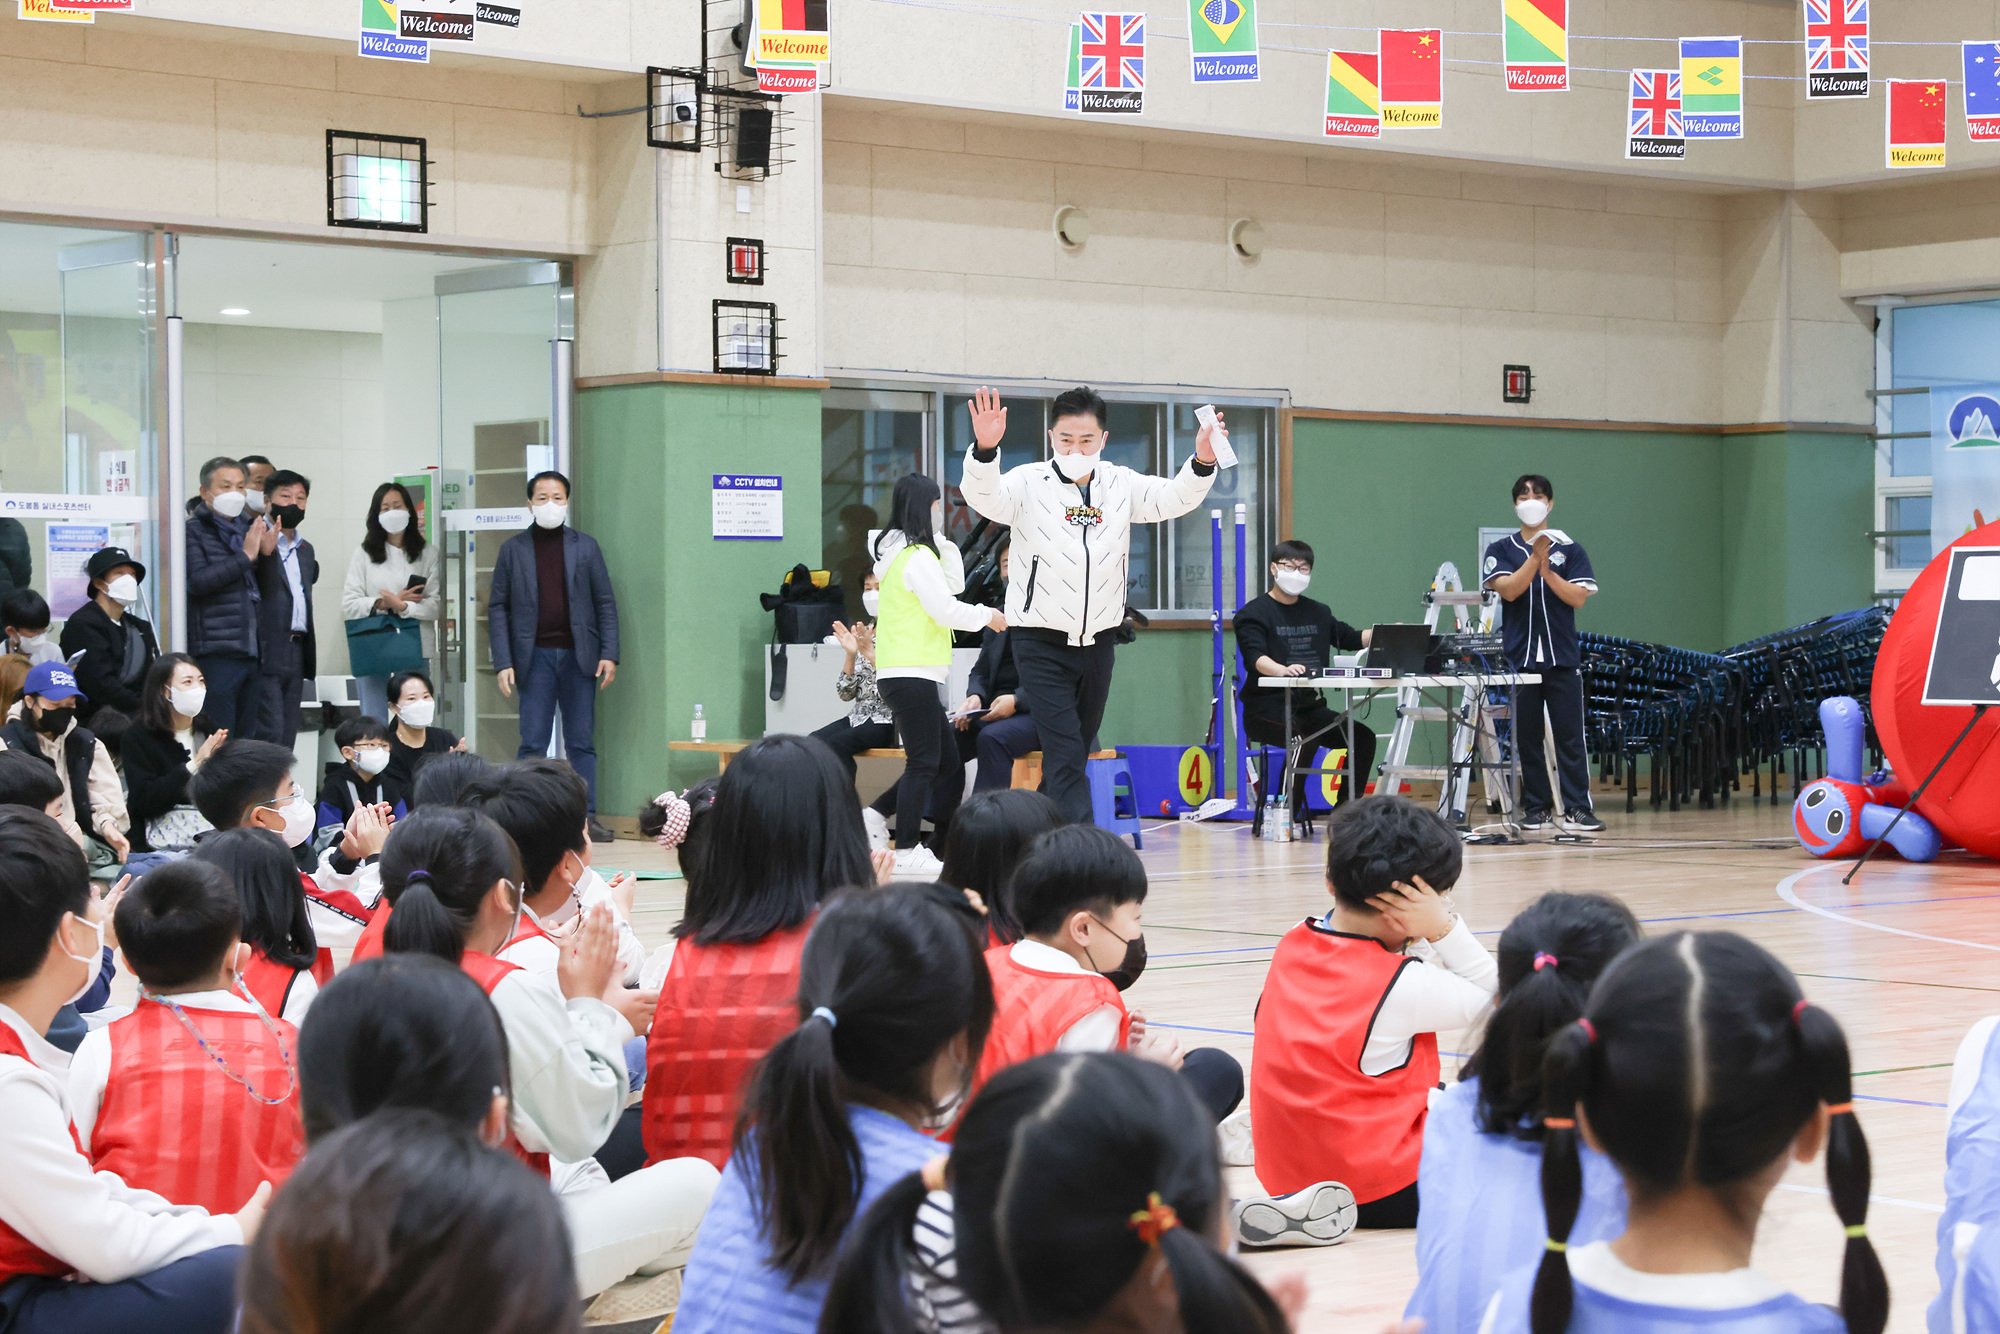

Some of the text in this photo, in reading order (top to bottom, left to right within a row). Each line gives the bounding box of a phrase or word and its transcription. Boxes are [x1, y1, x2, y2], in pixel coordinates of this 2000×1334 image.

[401, 15, 473, 35] Welcome
[362, 36, 427, 56] Welcome
[762, 38, 828, 55] Welcome
[1194, 61, 1257, 77] Welcome
[1507, 69, 1566, 85] Welcome
[757, 72, 816, 88] Welcome
[1810, 77, 1868, 92] Welcome
[1082, 93, 1141, 109] Welcome
[1383, 109, 1439, 123] Welcome
[1326, 119, 1379, 134] Welcome
[1683, 119, 1740, 133] Welcome
[1631, 141, 1684, 155] Welcome
[1891, 150, 1945, 162] Welcome
[734, 477, 754, 487] CCTV
[1186, 753, 1203, 795] 4
